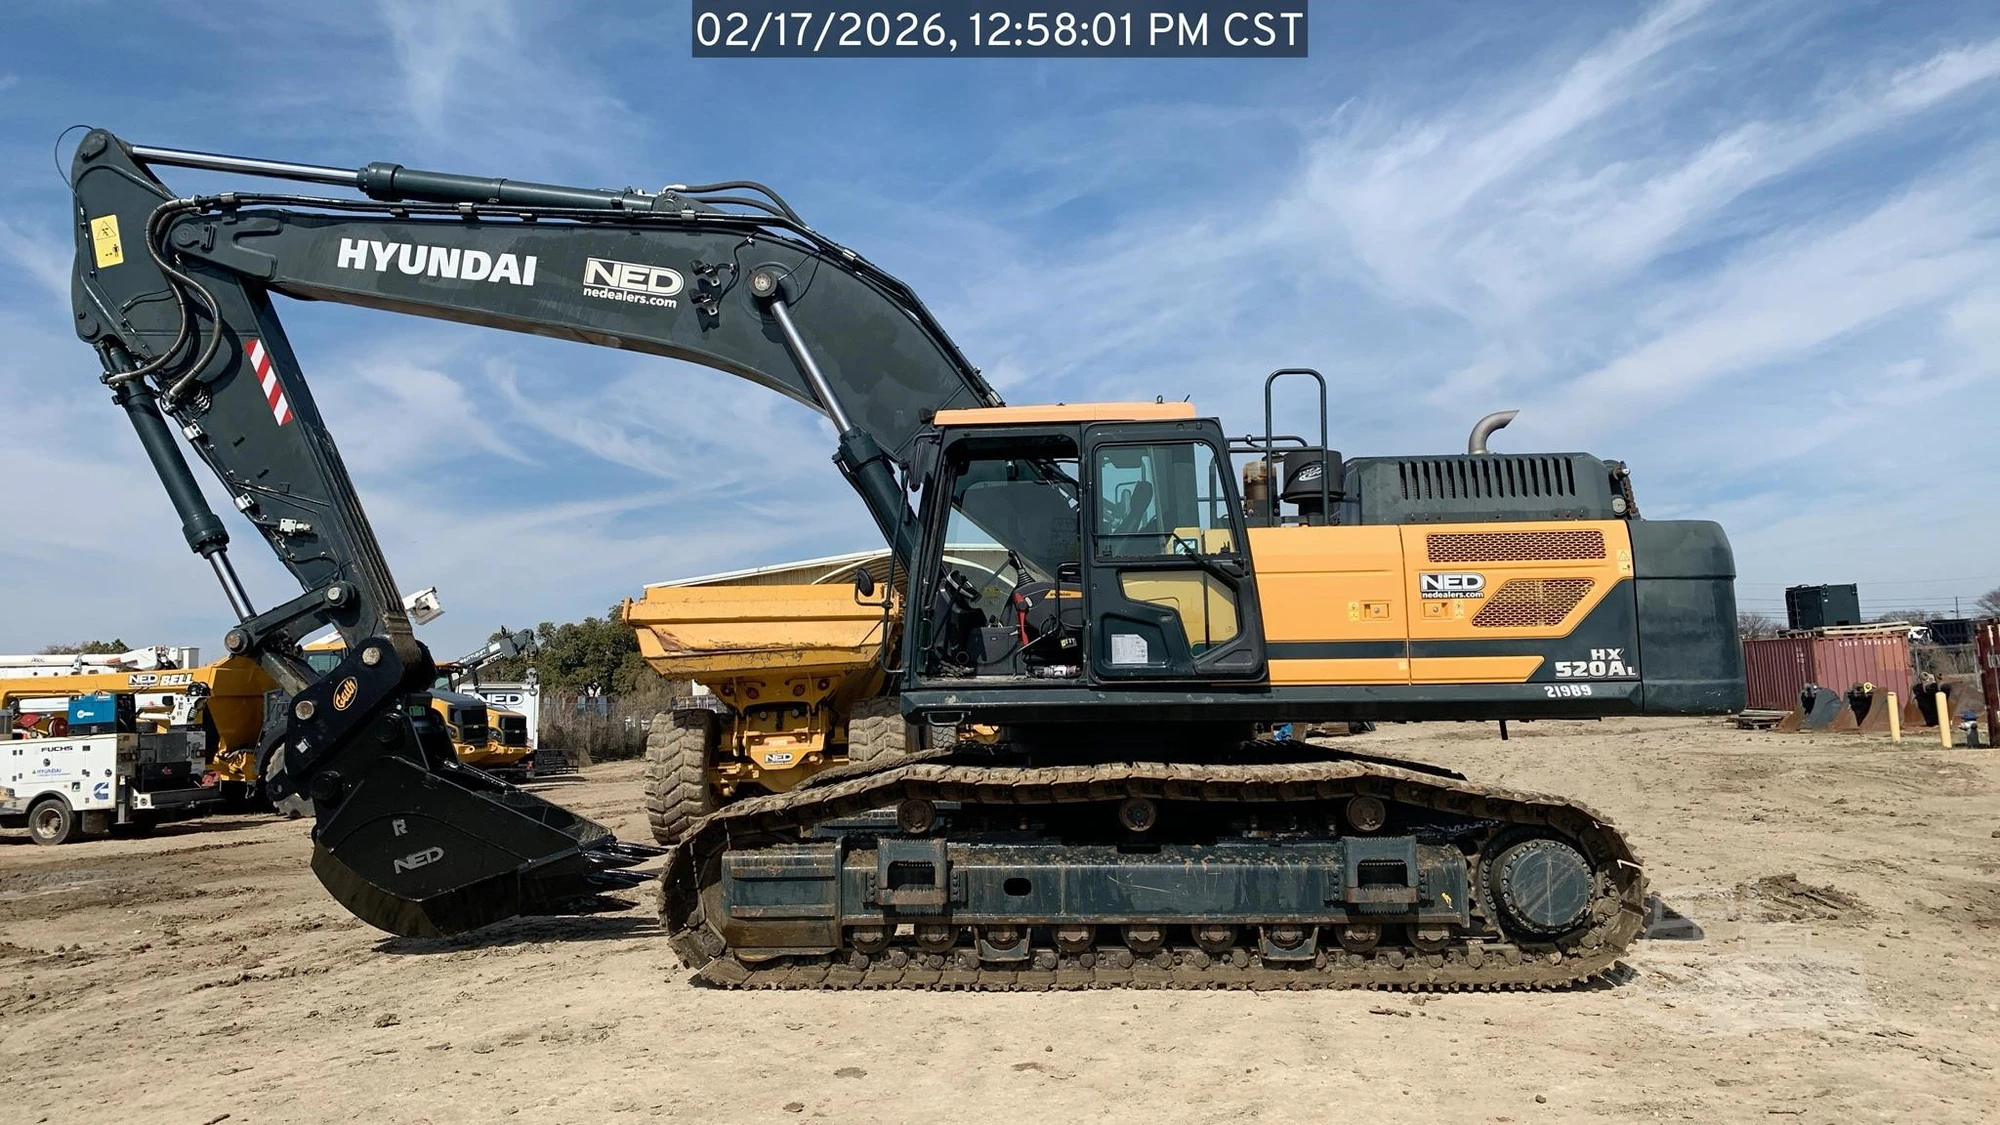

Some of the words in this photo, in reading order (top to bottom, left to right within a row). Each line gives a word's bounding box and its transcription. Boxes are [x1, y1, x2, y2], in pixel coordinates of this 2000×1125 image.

[337, 237, 538, 286] HYUNDAI
[585, 260, 681, 294] NED
[583, 287, 677, 309] nedealers.com
[1421, 574, 1485, 591] NED
[1590, 648, 1623, 661] HX
[129, 674, 159, 684] NED
[160, 673, 194, 686] BELL
[1543, 684, 1593, 698] 21989
[40, 745, 74, 753] FUCHS
[392, 819, 408, 837] R
[393, 846, 445, 875] NED
